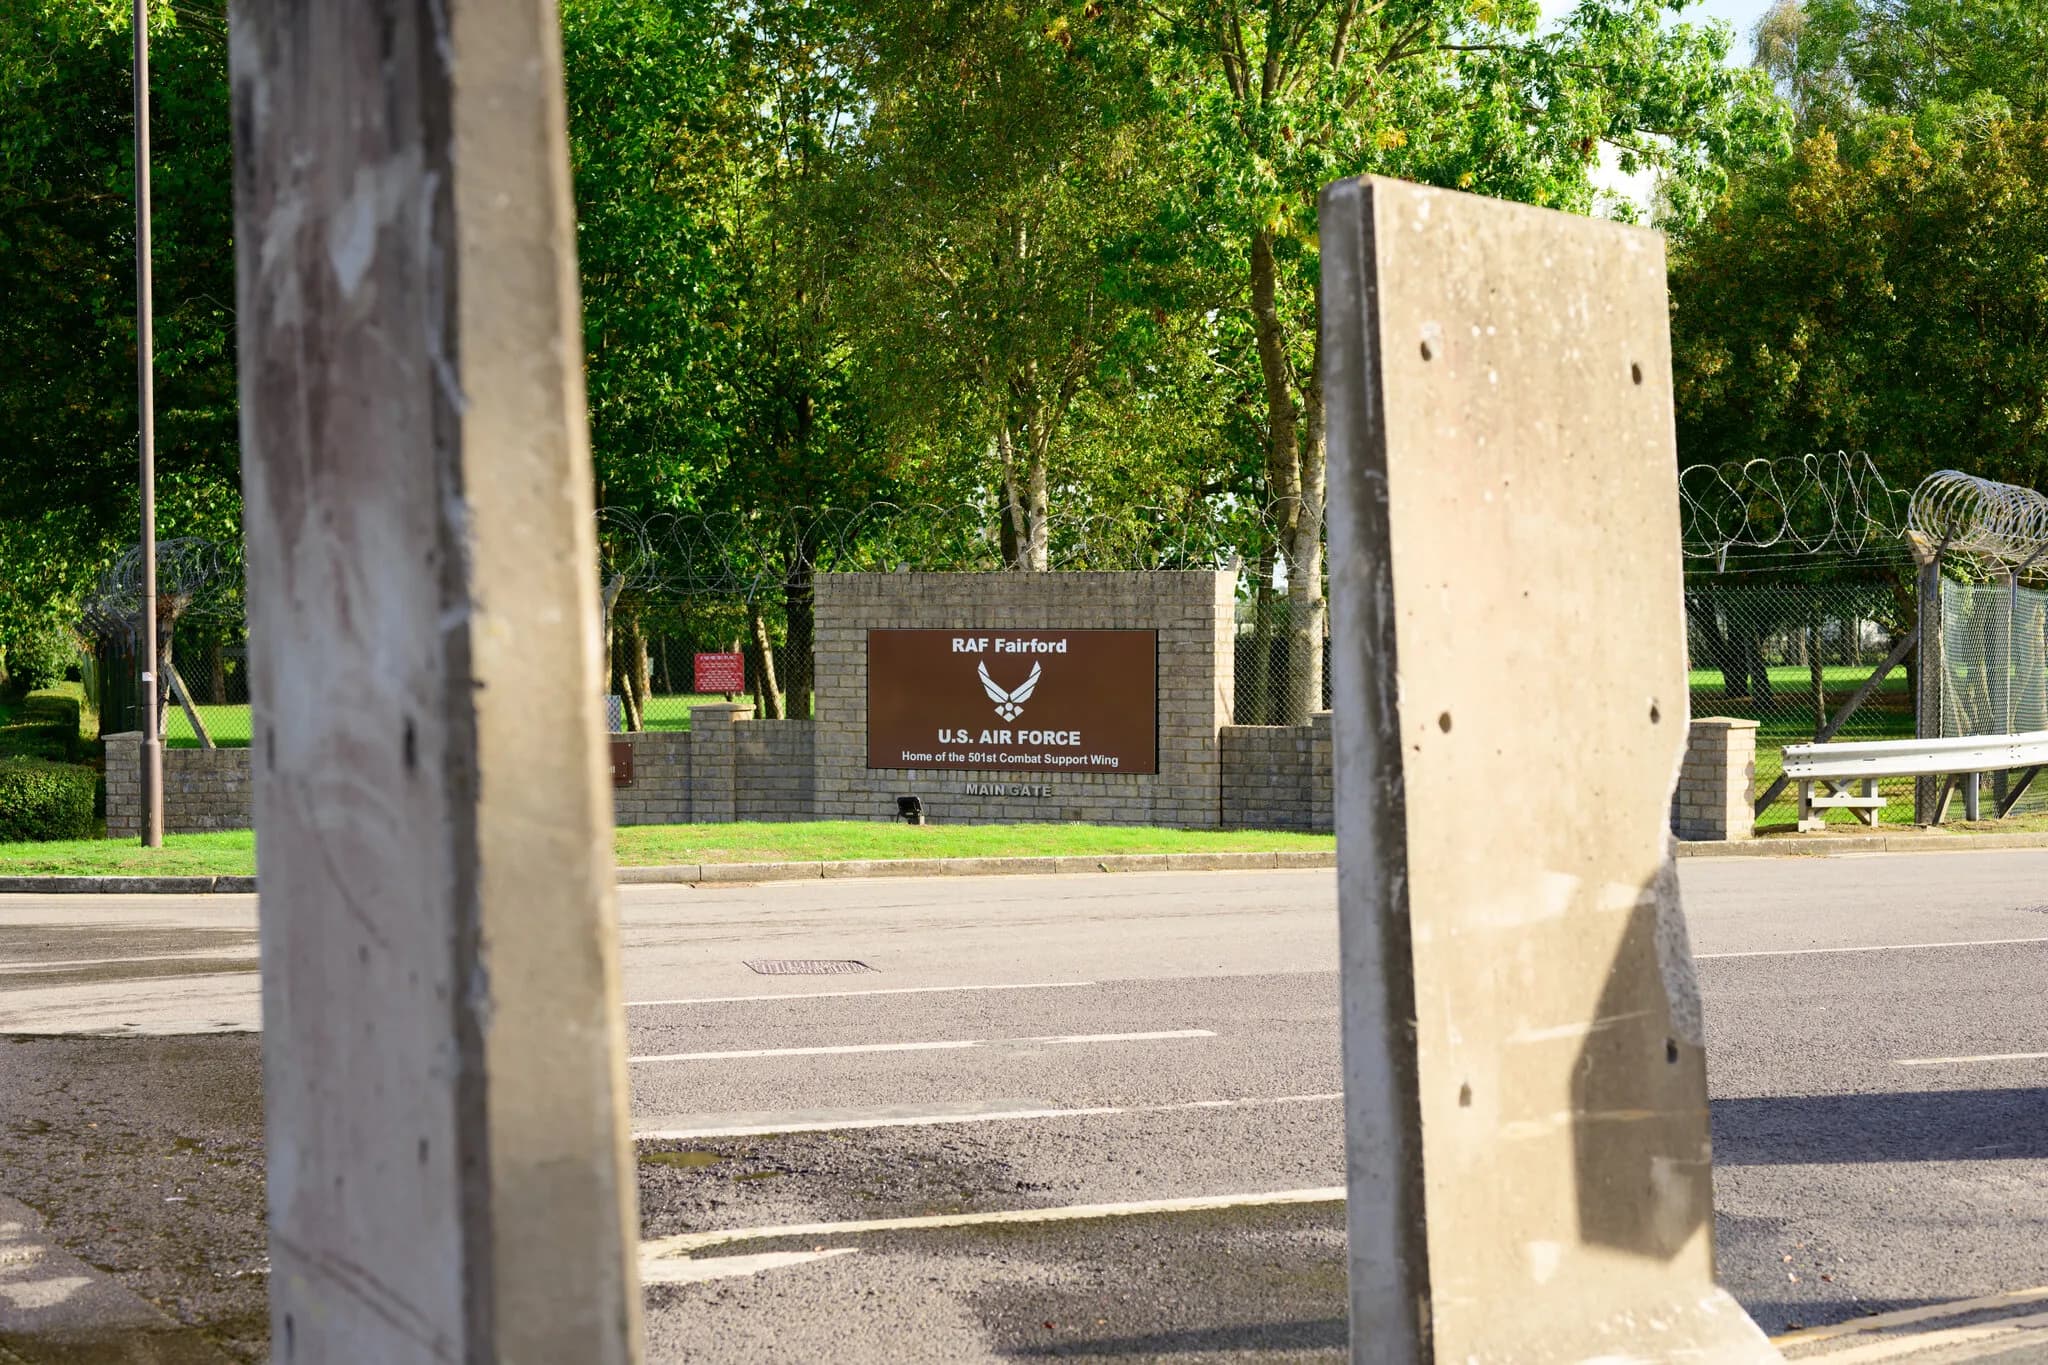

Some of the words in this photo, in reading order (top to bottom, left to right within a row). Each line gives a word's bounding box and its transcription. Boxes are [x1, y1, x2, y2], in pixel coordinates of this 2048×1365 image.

[952, 638, 989, 653] RAF
[995, 638, 1067, 654] Fairford
[938, 729, 974, 744] U.S.
[979, 730, 1012, 745] AIR
[1018, 731, 1081, 746] FORCE
[902, 751, 932, 761] Home
[935, 751, 946, 762] of
[948, 752, 965, 763] the
[968, 752, 997, 763] 501st
[999, 753, 1041, 764] Combat
[1044, 754, 1088, 767] Support
[1090, 755, 1119, 768] Wing
[966, 783, 1005, 795] MAIN
[1010, 784, 1052, 797] GATE
